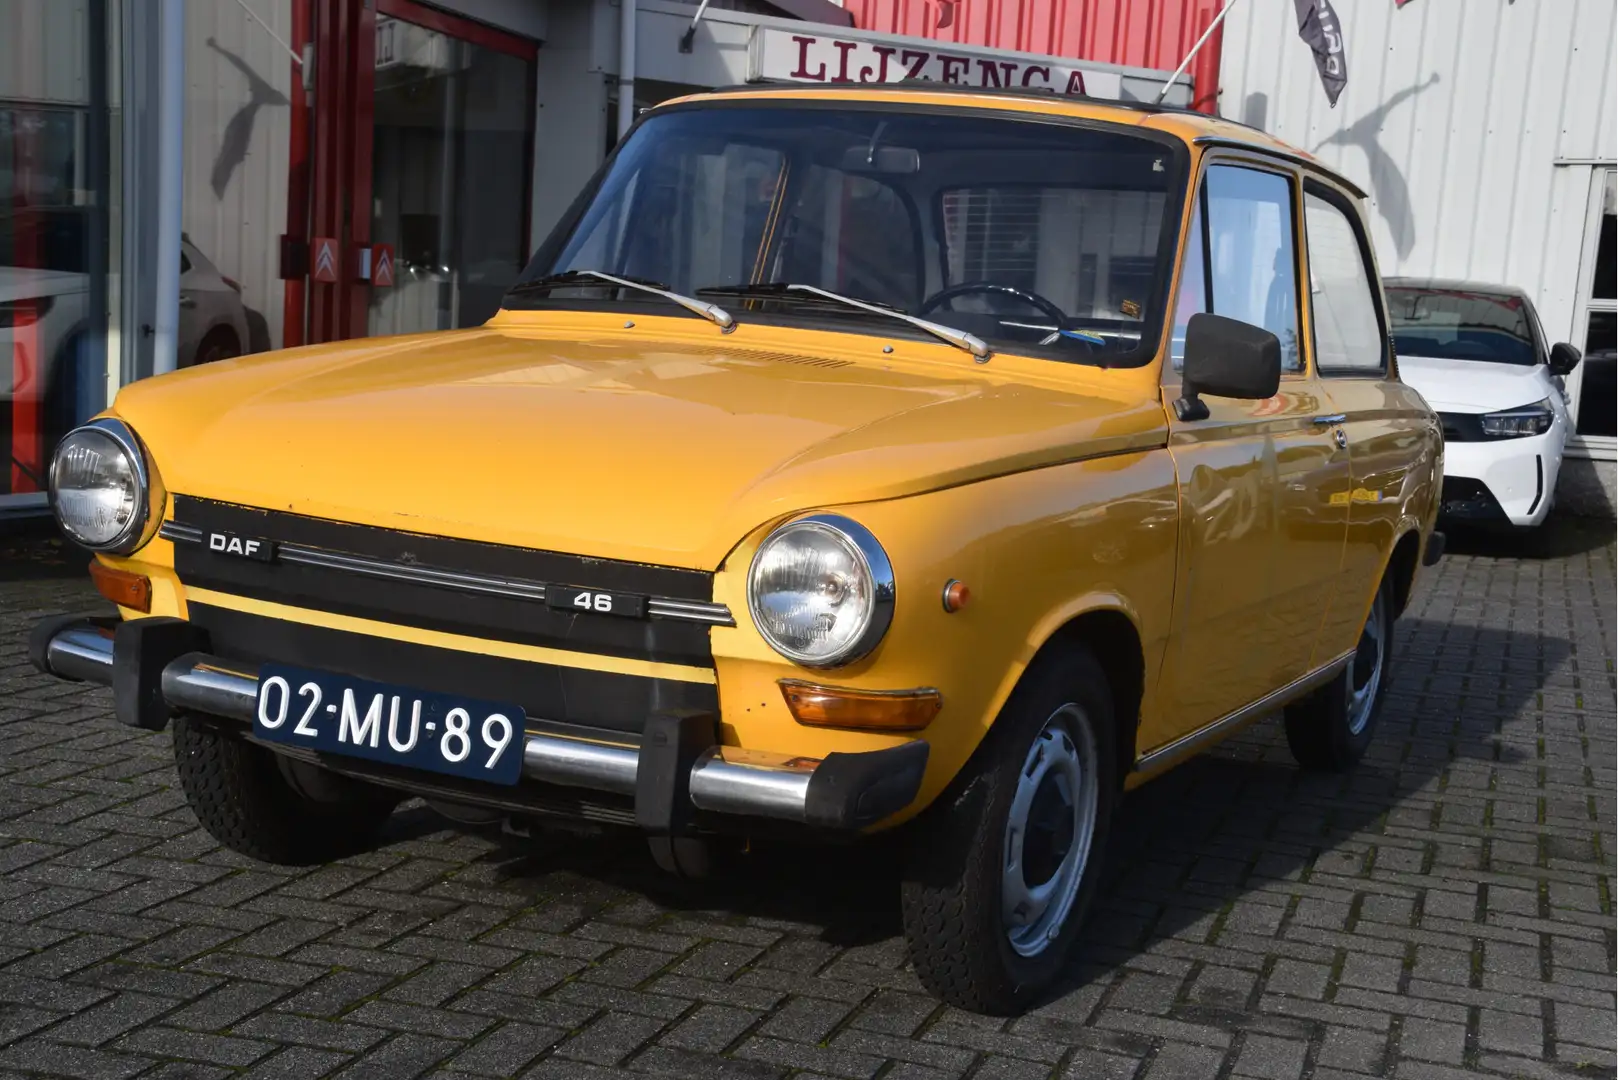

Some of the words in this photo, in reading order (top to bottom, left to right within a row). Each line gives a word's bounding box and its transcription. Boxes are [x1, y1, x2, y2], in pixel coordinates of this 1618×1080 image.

[210, 533, 261, 556] DAF
[573, 592, 612, 612] 46
[257, 675, 513, 769] 02-MU-89
